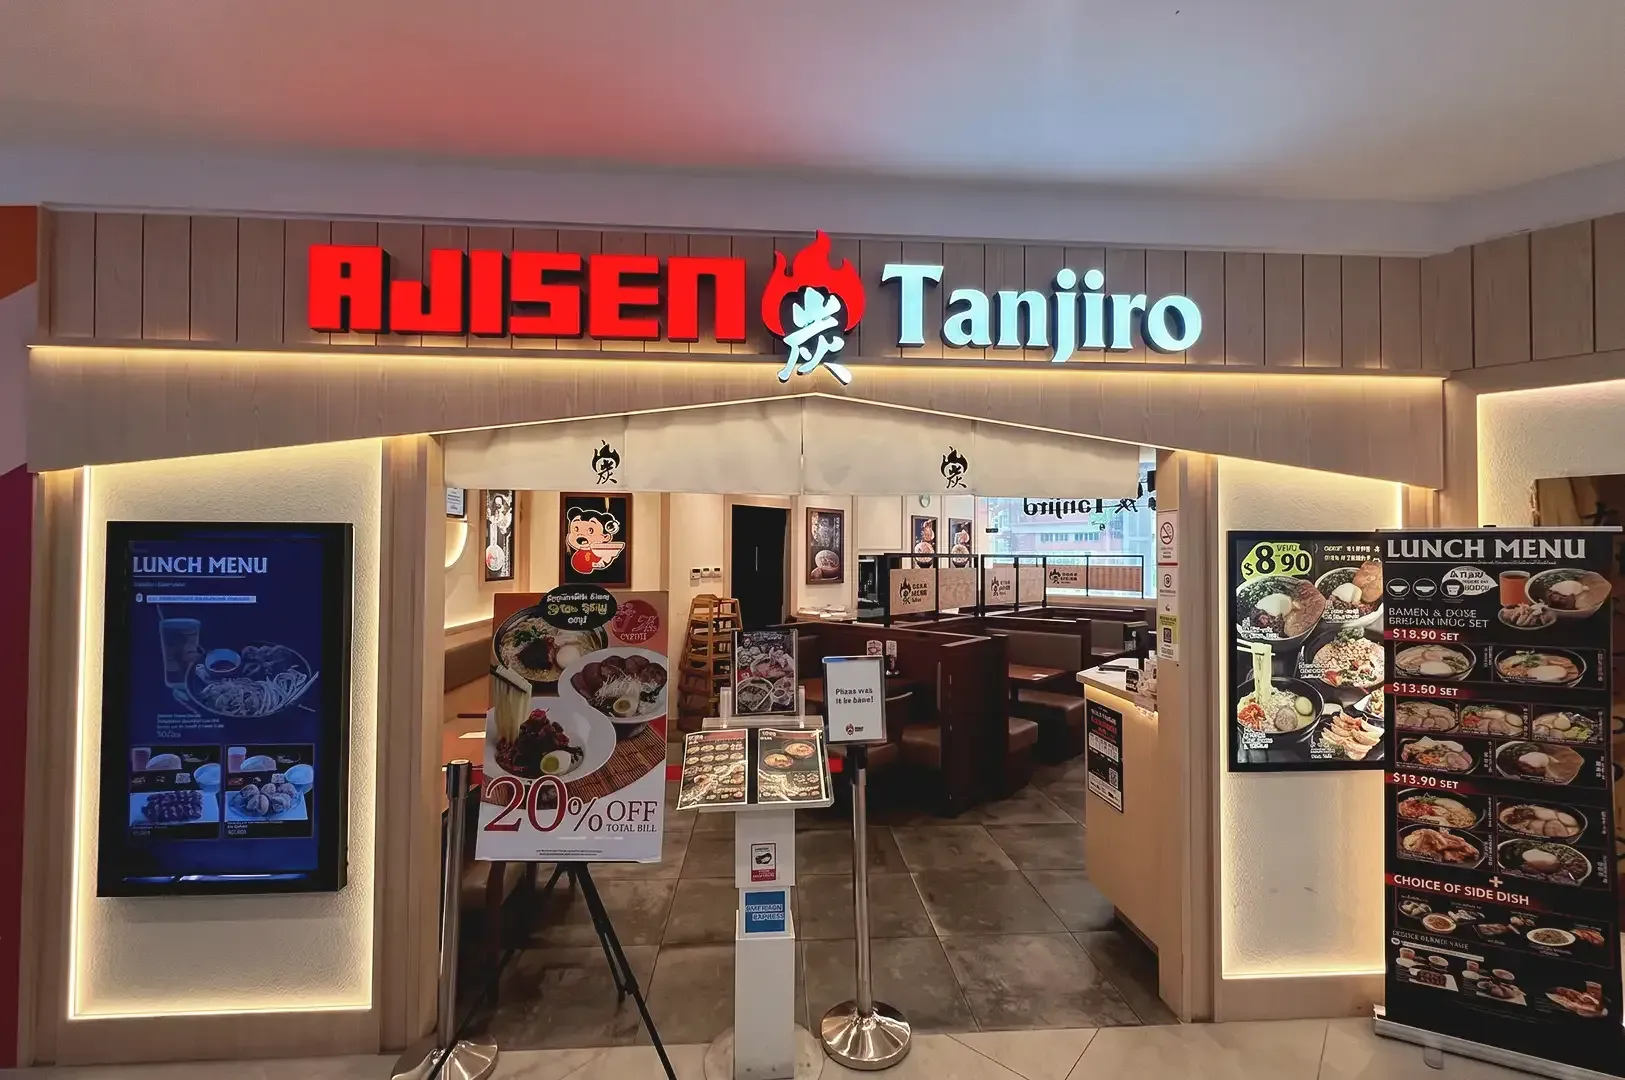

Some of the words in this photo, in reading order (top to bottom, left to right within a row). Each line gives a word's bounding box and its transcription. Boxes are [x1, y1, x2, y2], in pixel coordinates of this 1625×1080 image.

[309, 245, 746, 342] AJISEN
[881, 263, 1203, 363] Tanjiro
[1387, 538, 1485, 559] LUNCH
[1494, 538, 1587, 559] MENU
[133, 556, 202, 573] LUNCH
[208, 557, 268, 573] MENU
[1393, 628, 1437, 640] $18.90
[1440, 632, 1460, 641] SET
[1440, 687, 1459, 697] SET
[1393, 772, 1437, 788] $13.90
[1440, 779, 1459, 789] SET
[484, 776, 603, 833] 20%
[606, 800, 658, 822] OFF
[605, 823, 635, 832] TOTAL
[637, 823, 658, 833] BILL
[1394, 874, 1441, 892] CHOICE
[1444, 881, 1461, 894] OF
[1464, 885, 1494, 901] SIDE
[1496, 890, 1530, 907] DISH
